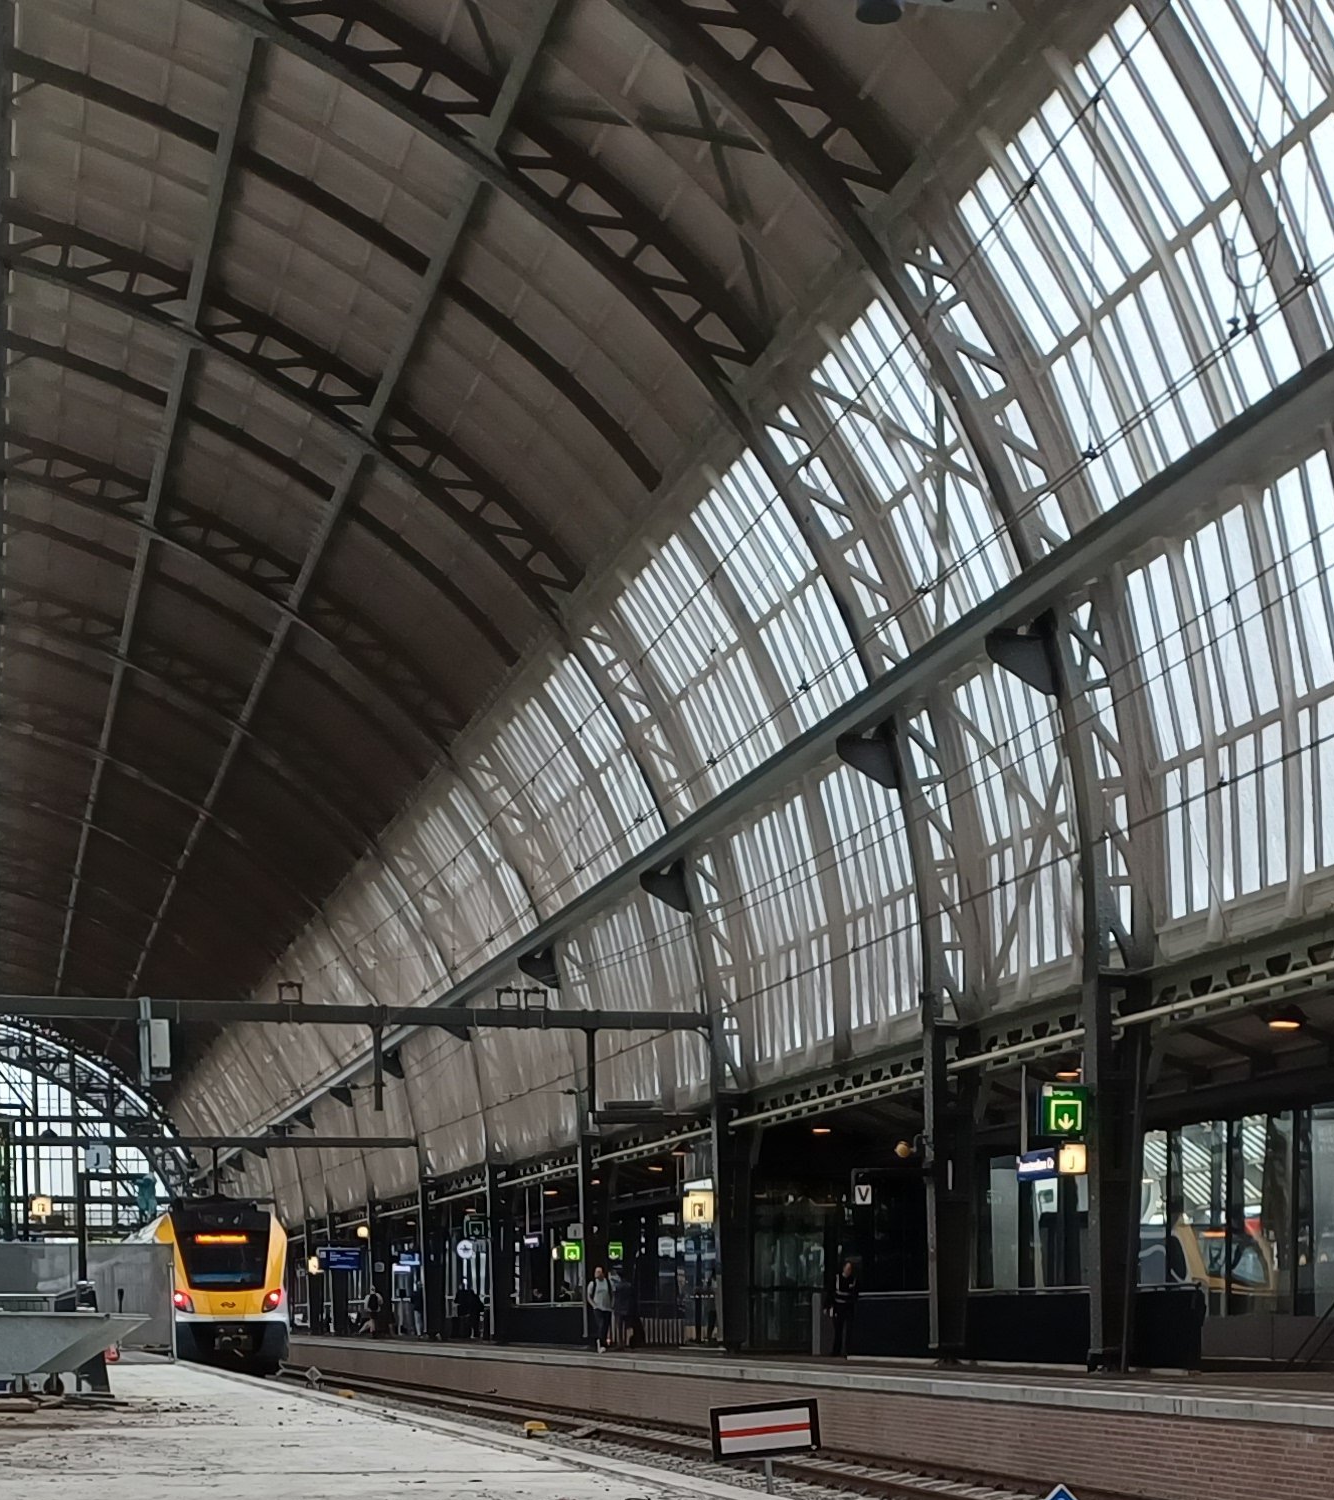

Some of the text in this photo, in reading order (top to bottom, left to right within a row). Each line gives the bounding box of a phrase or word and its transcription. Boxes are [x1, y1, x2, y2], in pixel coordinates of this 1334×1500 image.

[93, 1152, 100, 1167] J
[1069, 1155, 1075, 1169] J
[857, 1187, 870, 1202] V
